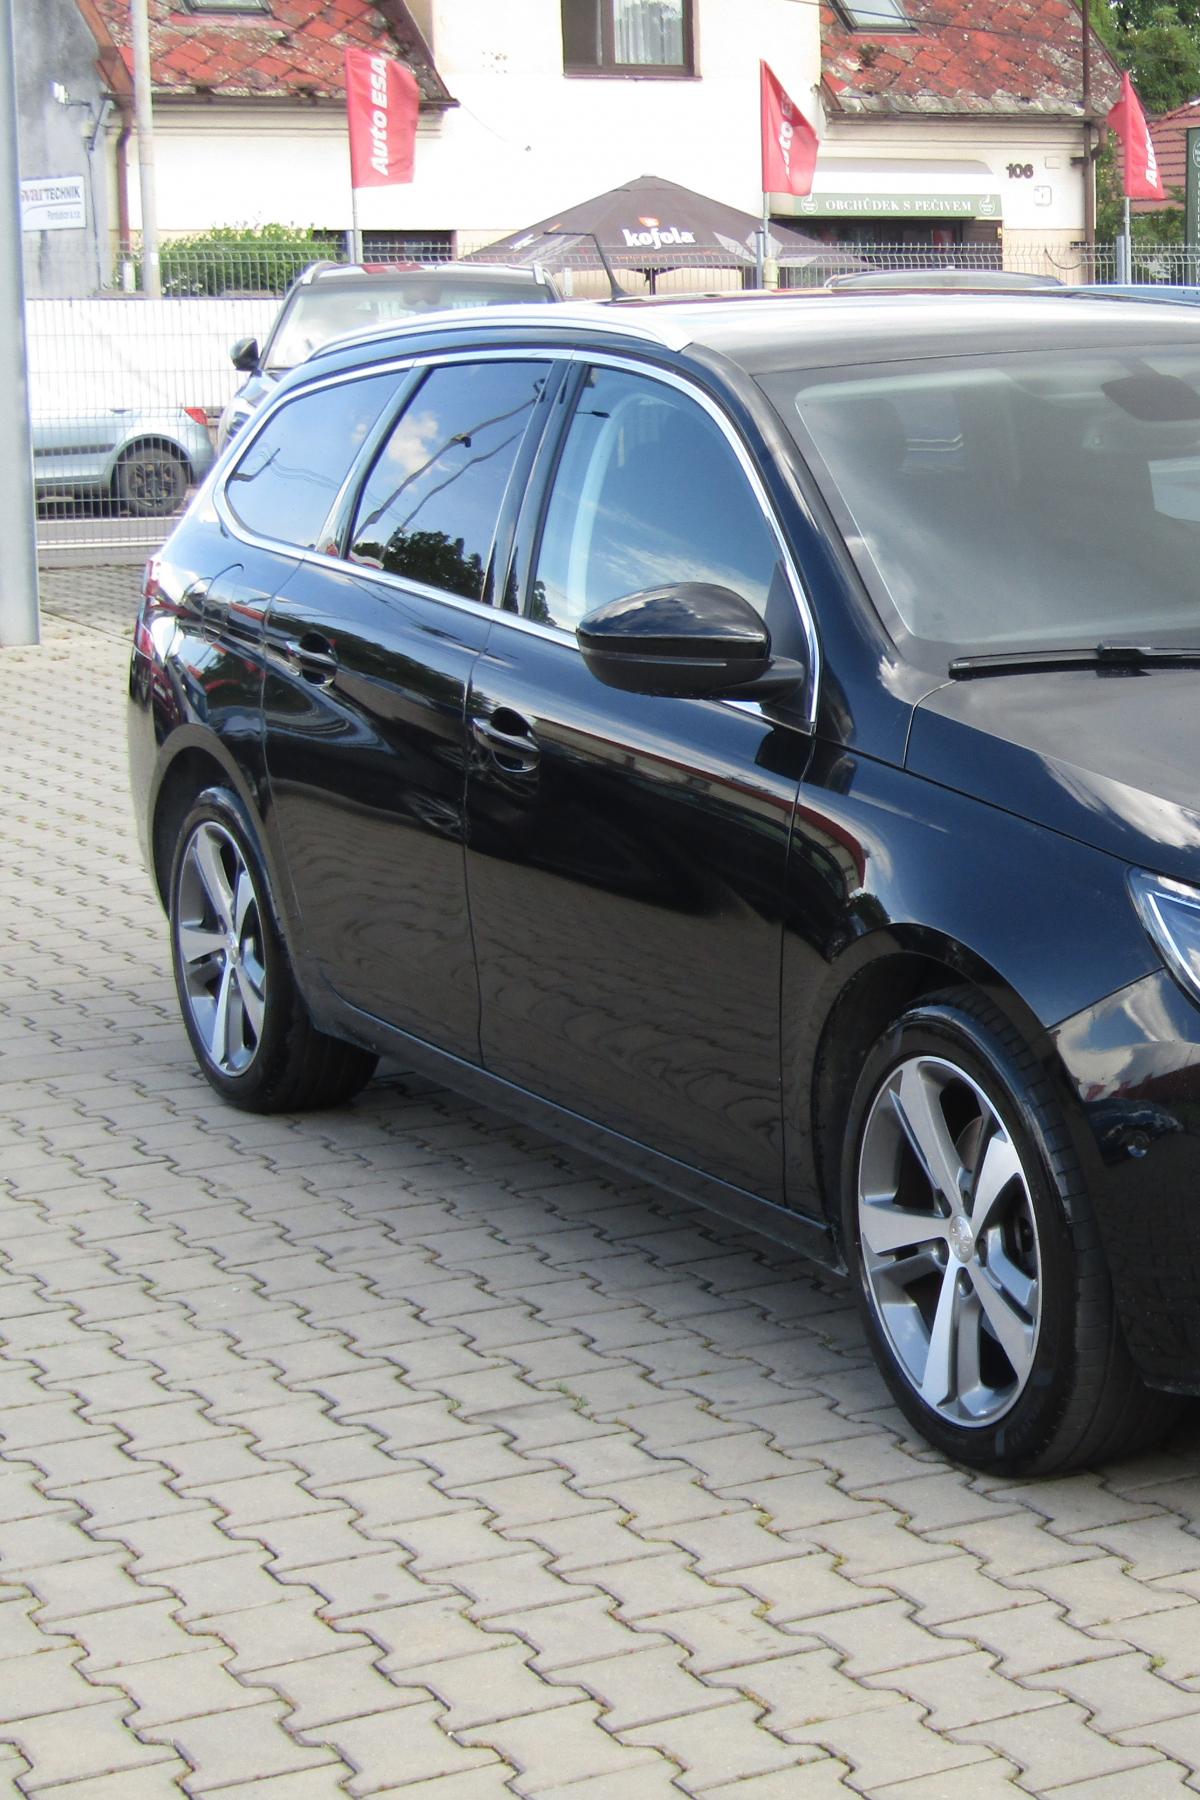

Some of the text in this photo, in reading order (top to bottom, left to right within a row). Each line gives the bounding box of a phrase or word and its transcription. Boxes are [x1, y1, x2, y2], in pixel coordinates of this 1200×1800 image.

[370, 58, 389, 177] Auto ESA
[1006, 163, 1034, 179] 106
[825, 198, 900, 212] OBCHŮDEK
[903, 200, 911, 212] S
[915, 199, 972, 212] PEČIVEM
[622, 227, 695, 250] kofola
